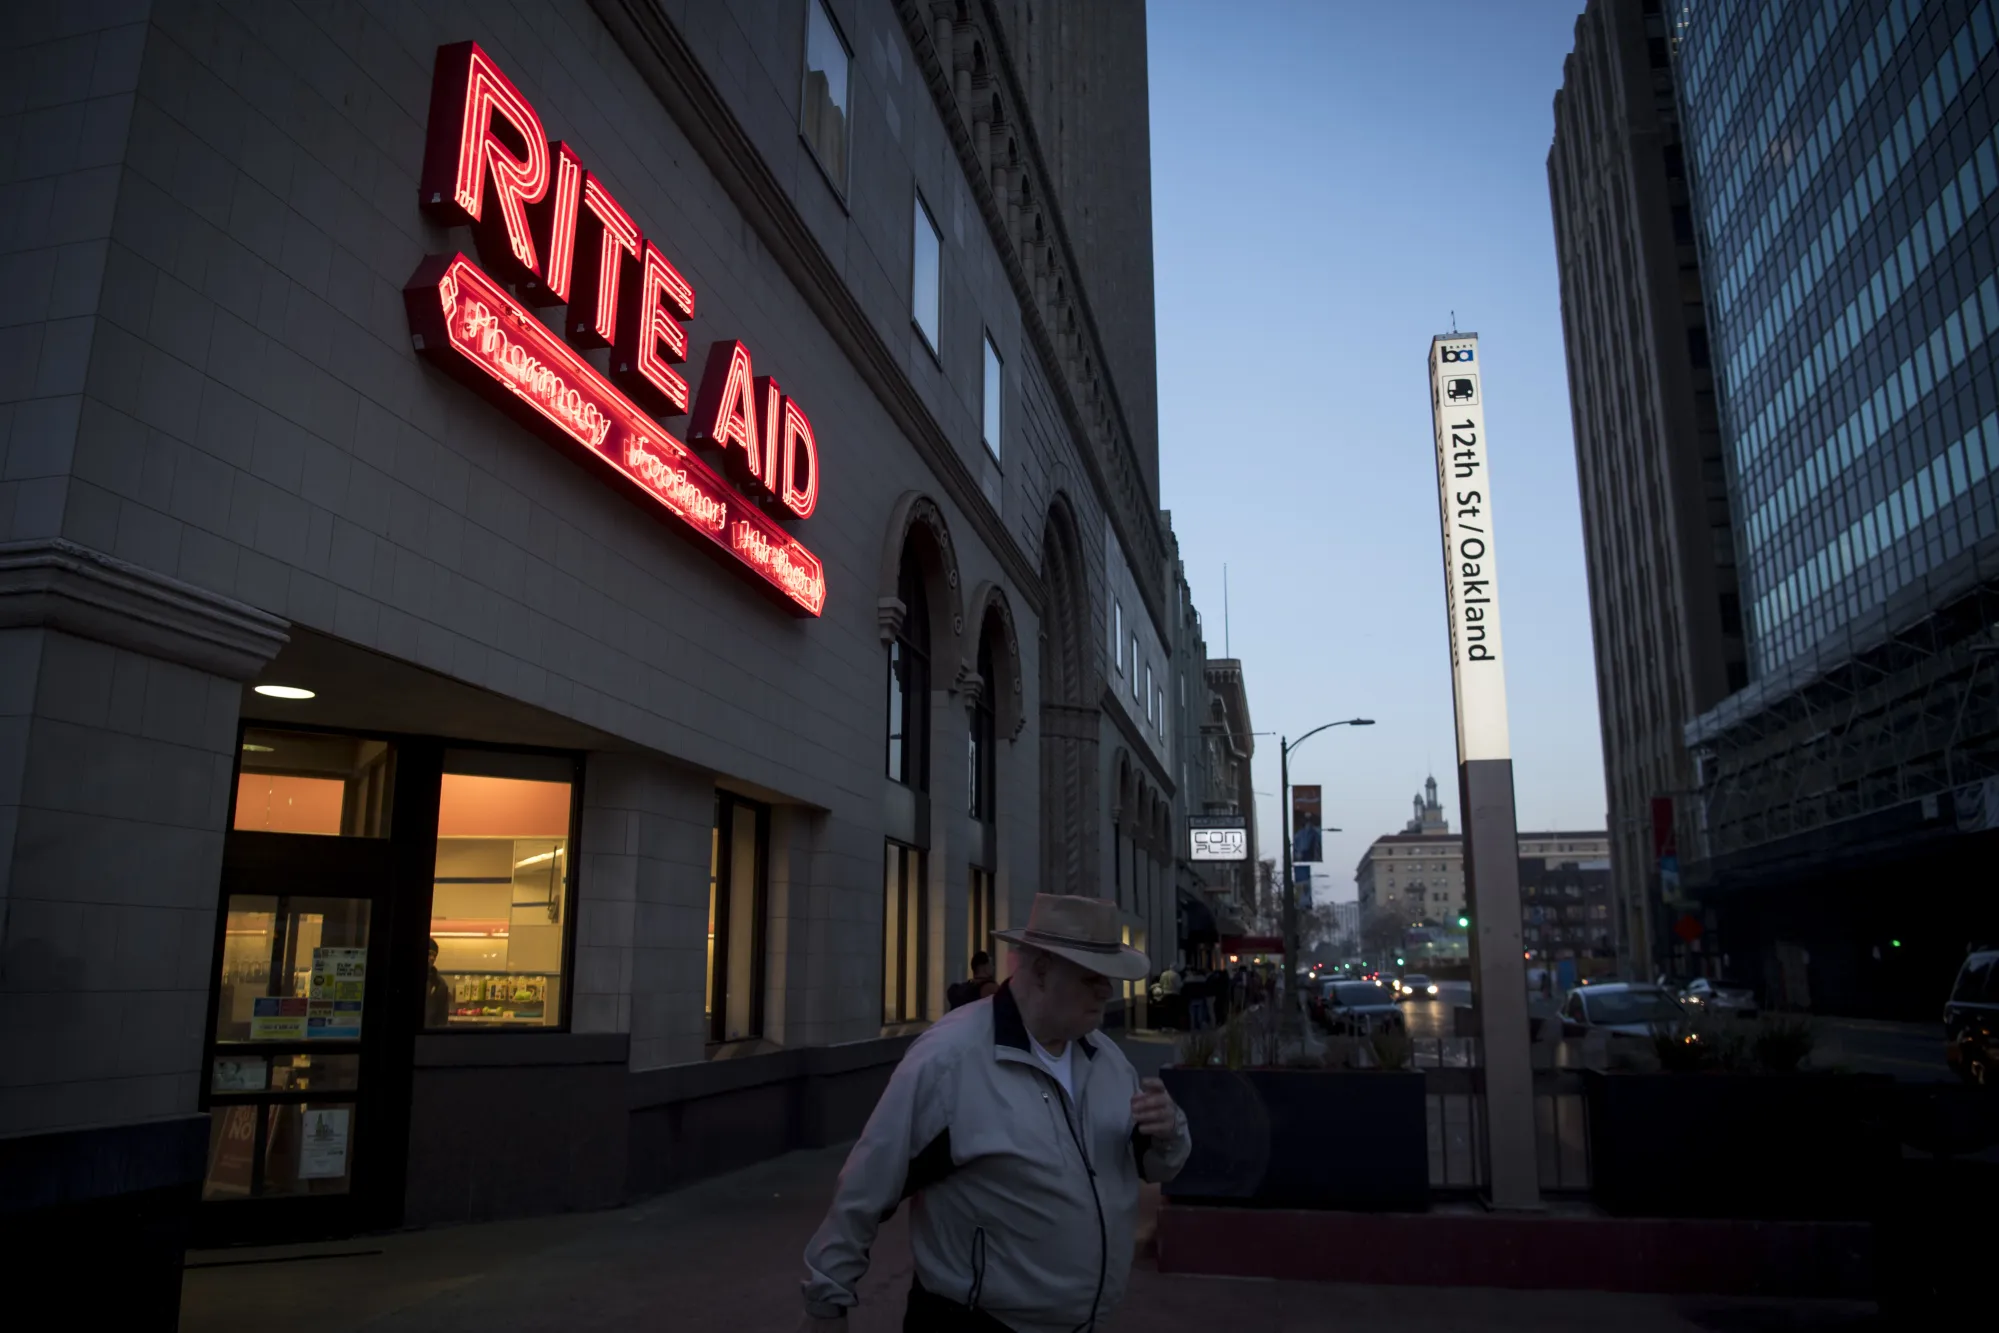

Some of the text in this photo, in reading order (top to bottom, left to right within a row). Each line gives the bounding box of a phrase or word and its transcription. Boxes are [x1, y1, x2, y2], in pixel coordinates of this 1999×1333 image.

[450, 40, 819, 519] RITE AID
[463, 301, 611, 445] Pharmacy
[1451, 418, 1496, 662] 12th St/Oakland
[1196, 844, 1242, 854] PLEX
